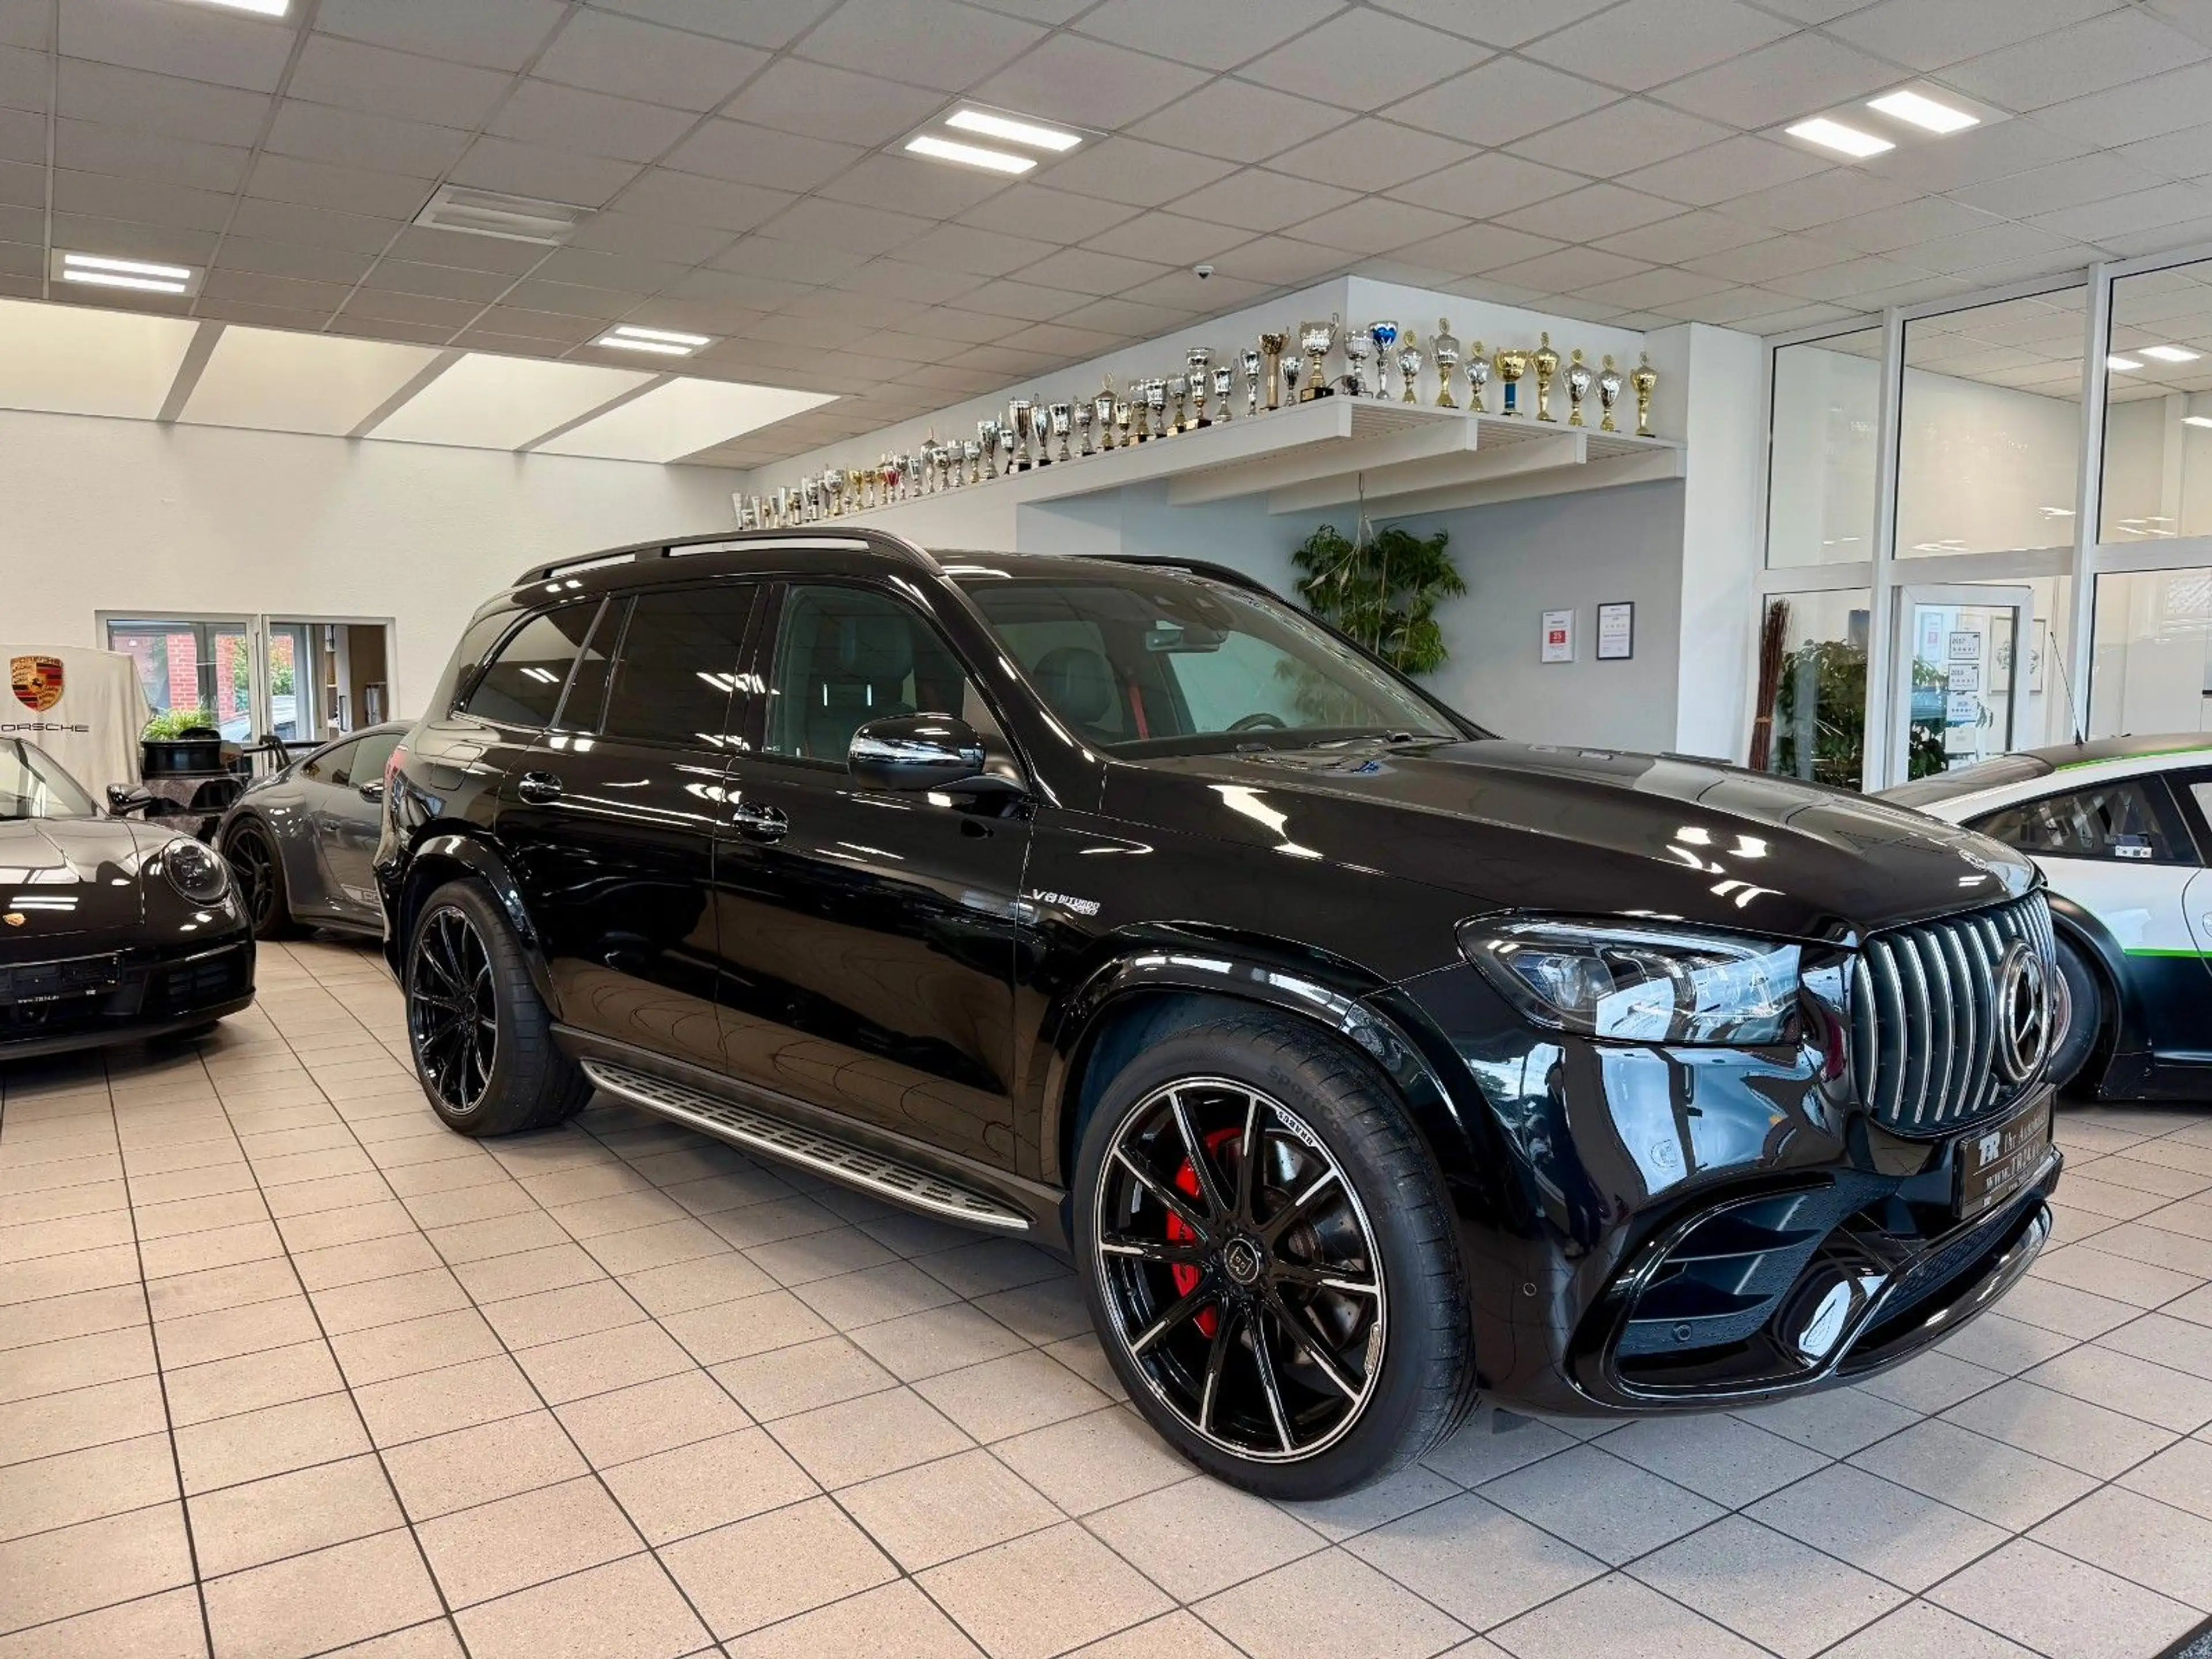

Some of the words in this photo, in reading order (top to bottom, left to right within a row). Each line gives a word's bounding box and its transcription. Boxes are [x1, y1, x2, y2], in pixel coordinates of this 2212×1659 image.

[1, 723, 89, 732] ORSCHE
[1032, 889, 1058, 904] V8
[1278, 1111, 1313, 1146] BRABUS
